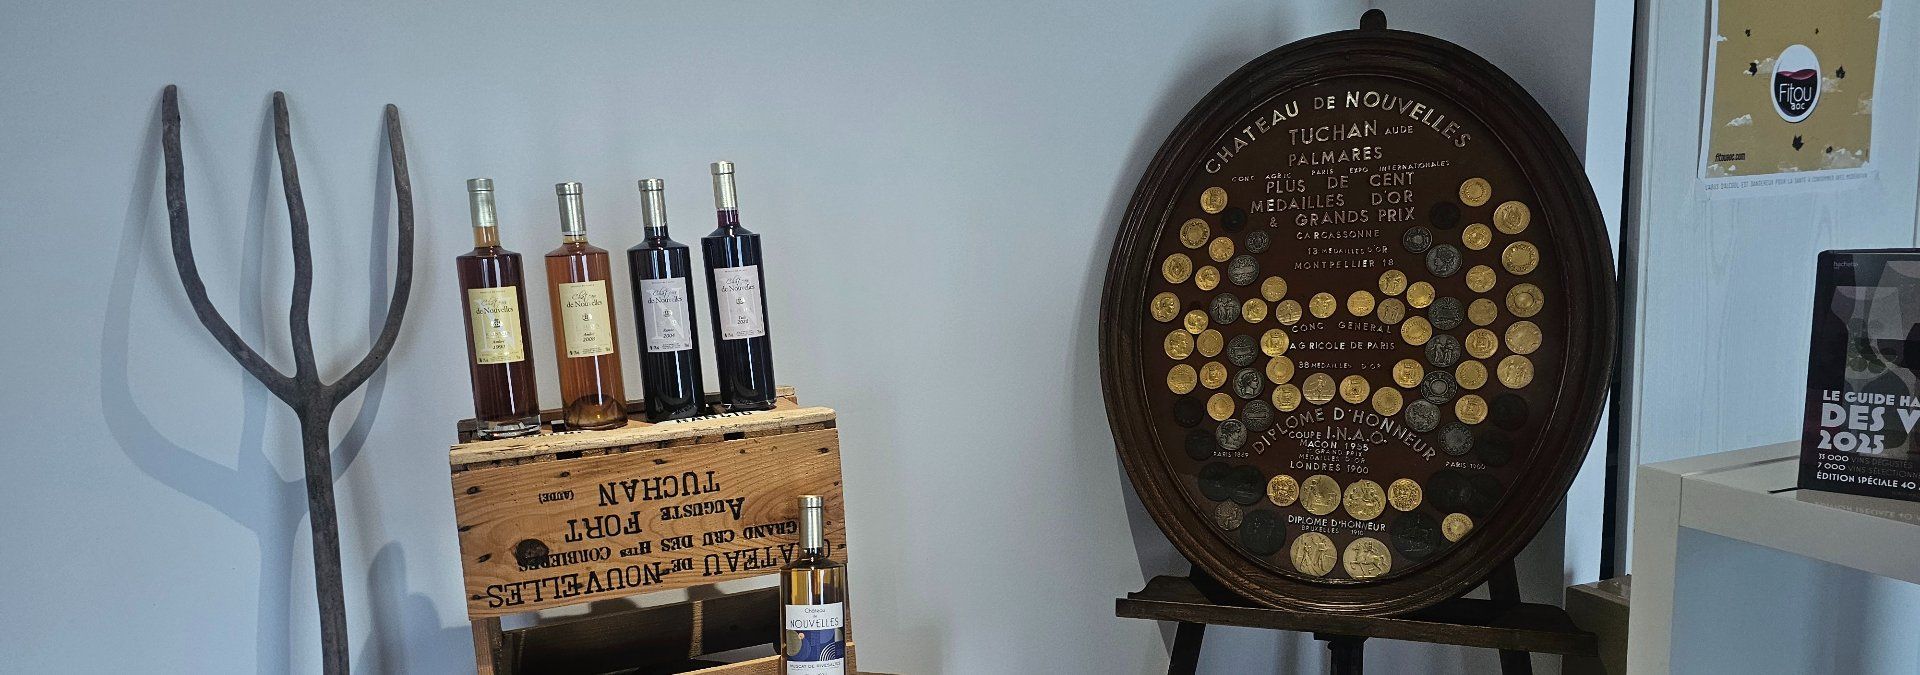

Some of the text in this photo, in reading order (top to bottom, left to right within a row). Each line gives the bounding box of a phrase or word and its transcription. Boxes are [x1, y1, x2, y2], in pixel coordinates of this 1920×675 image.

[1779, 83, 1812, 104] Fitou
[1206, 91, 1472, 174] CHATEAU DE NOUVELLES
[1289, 120, 1414, 145] TUCHAN AUDE
[1288, 147, 1382, 166] PALMARES
[1379, 160, 1450, 171] INTERNATIONALES
[1266, 172, 1414, 193] PLUS DE CENT
[1250, 190, 1412, 213] MEDAILLES D'OR
[1270, 207, 1414, 228] & GRANDS PRIX
[1296, 230, 1380, 240] CARCASSONNE
[1294, 260, 1374, 270] MONTPELLIER
[575, 299, 602, 308] Nouvelles
[1338, 322, 1392, 334] GENERAL
[1290, 342, 1394, 350] AGRICOLE DE PARIS
[1823, 390, 1840, 402] LE
[1844, 392, 1895, 406] GUIDE
[1821, 402, 1886, 432] DES
[1252, 407, 1436, 462] DIPLOME D'HONNEUR
[1289, 426, 1388, 444] COUPE I.N.A.O.
[1300, 439, 1337, 448] MACON
[1817, 430, 1884, 454] 2025
[1290, 461, 1340, 472] LONDRES
[538, 471, 720, 507] TUCHAN (AUDE)
[1816, 472, 1916, 490] ÉDITION SPÉCIALE 40
[565, 511, 642, 542] FORT
[743, 520, 798, 540] GRAND
[1288, 514, 1386, 531] DIPLOME D'HONNEUR
[1302, 525, 1339, 534] BRUXELLES
[661, 534, 693, 552] DES
[702, 529, 734, 546] CRU
[671, 558, 694, 573] DE
[486, 562, 663, 608] NOUVELLES
[790, 617, 838, 628] NOUVELLES
